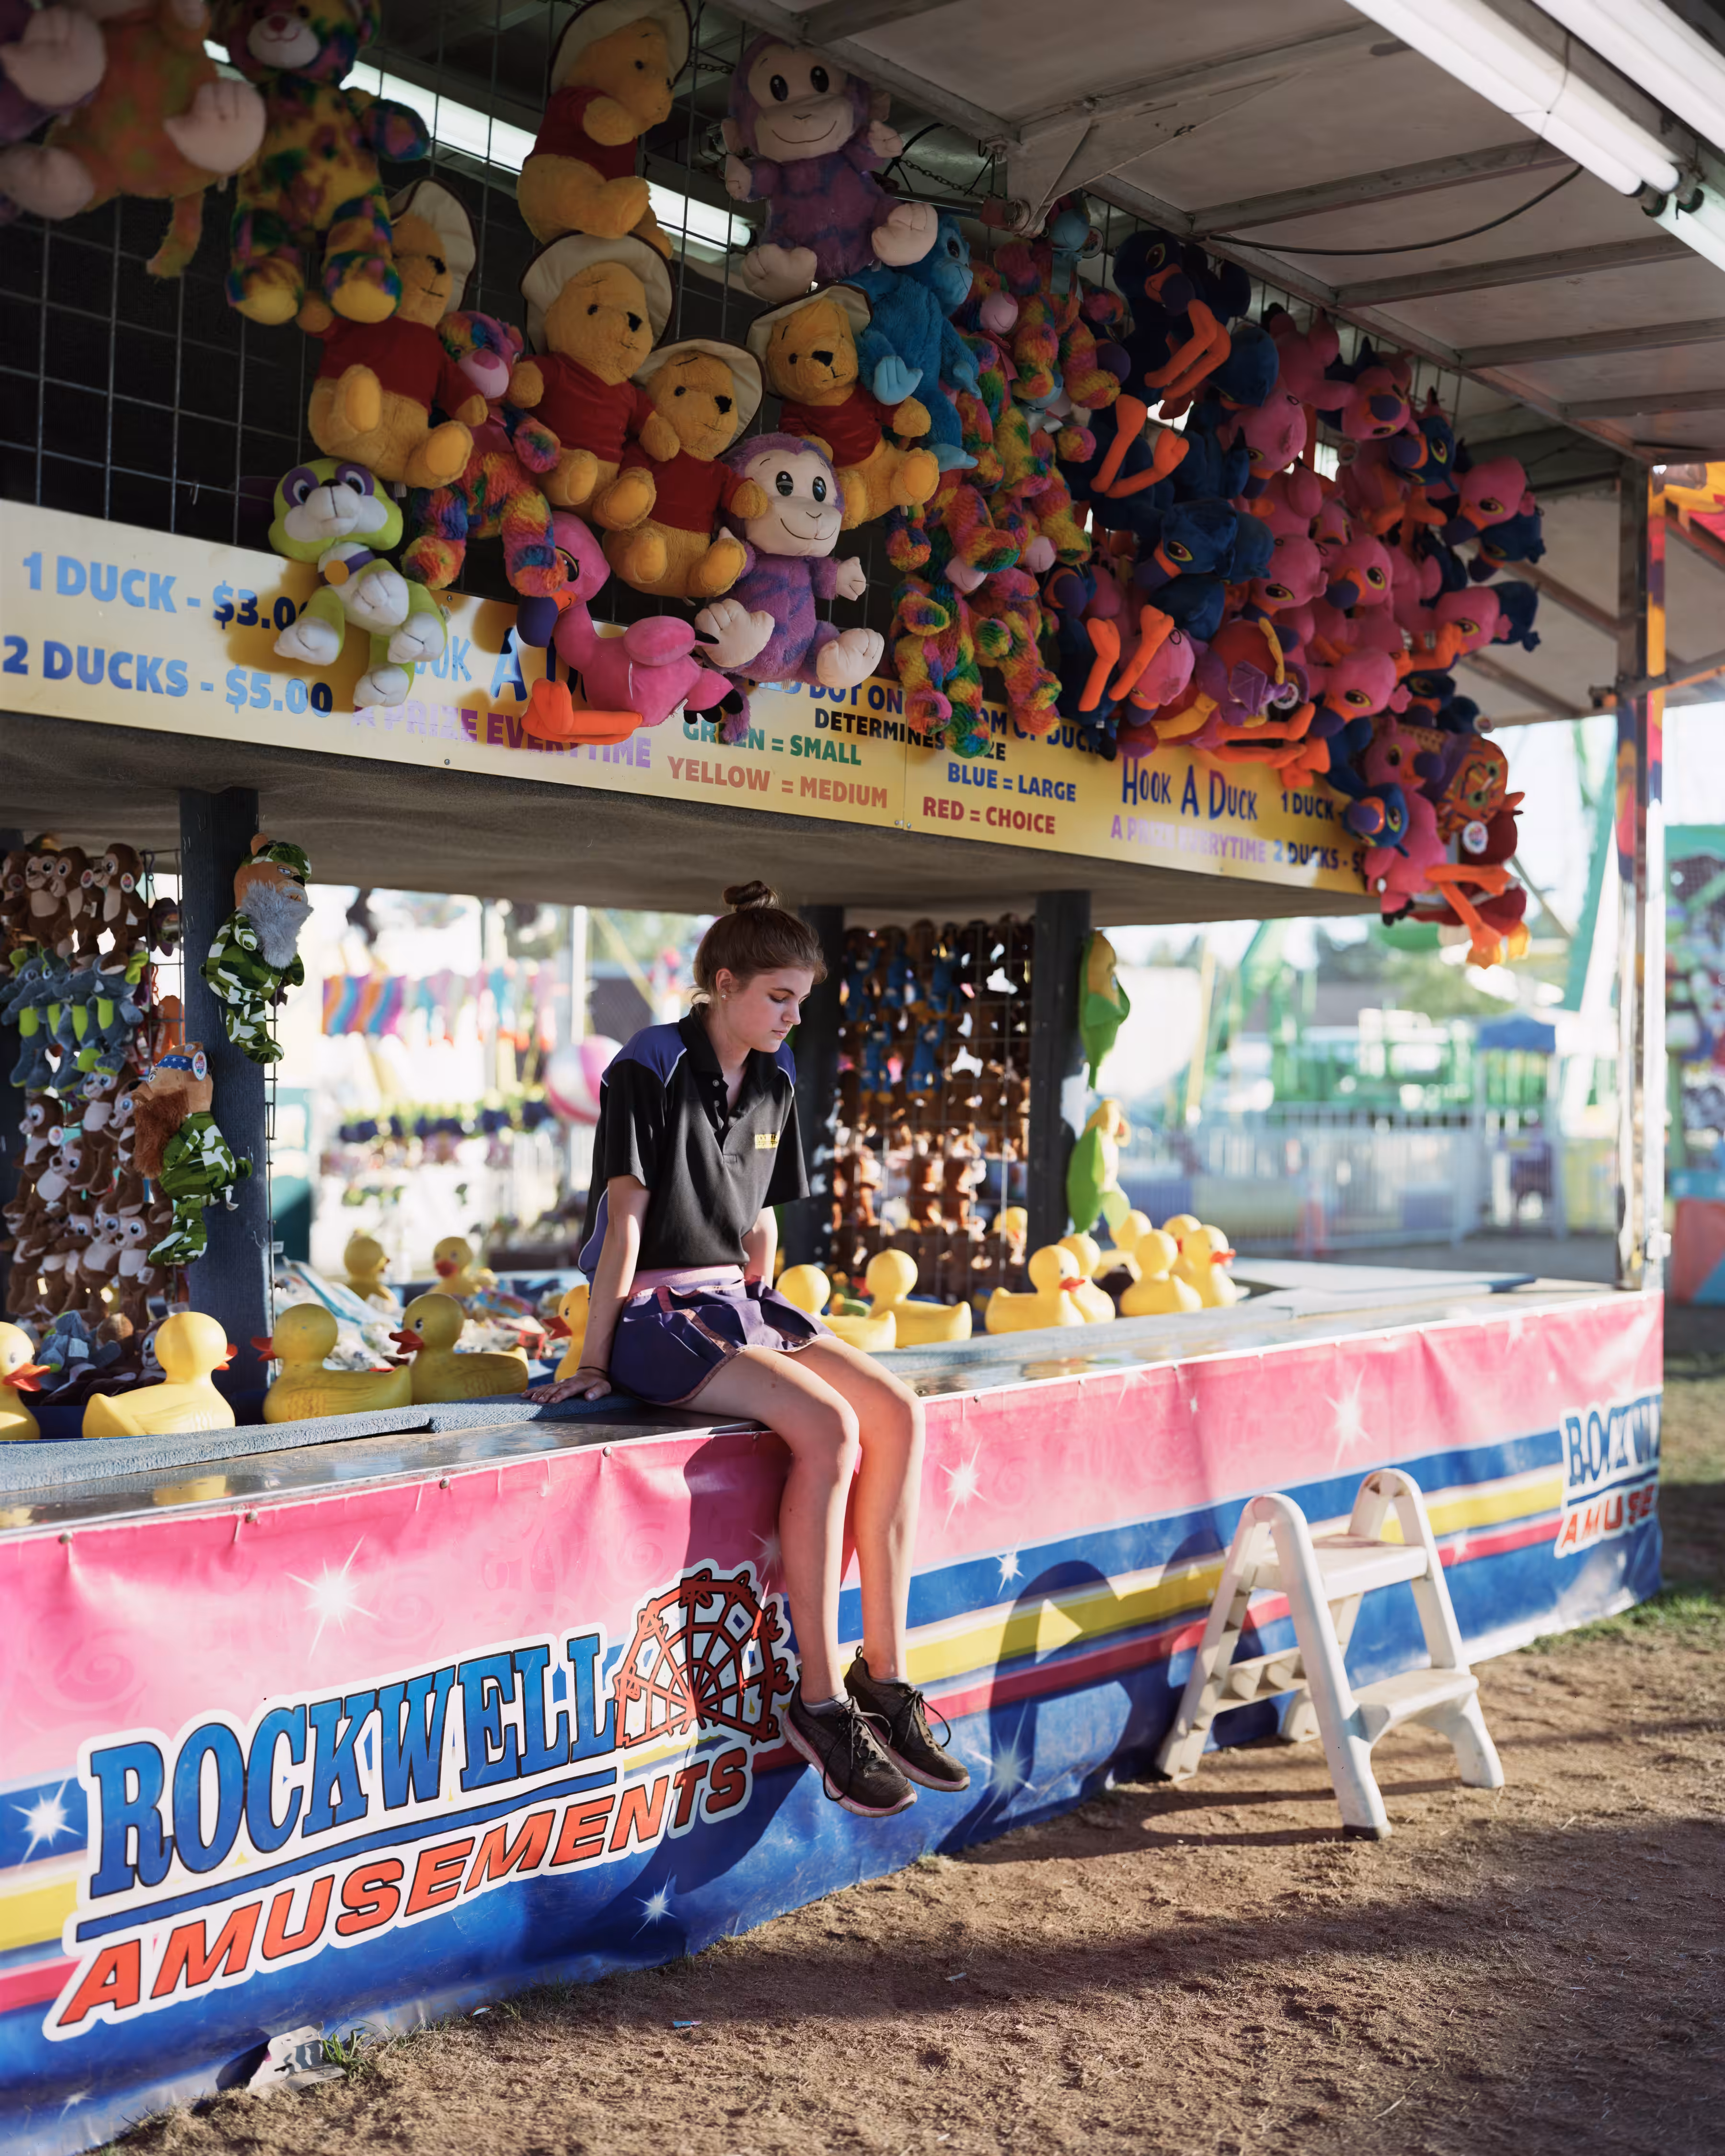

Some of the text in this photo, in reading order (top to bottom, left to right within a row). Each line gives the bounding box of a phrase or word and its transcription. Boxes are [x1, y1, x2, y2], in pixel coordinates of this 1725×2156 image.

[23, 552, 42, 591] 1
[56, 555, 177, 613] DUCK
[213, 580, 308, 632] $3.0
[2, 635, 29, 675] 2
[43, 641, 188, 697] DUCKS
[226, 664, 334, 718] $5.00
[490, 627, 528, 702] A
[868, 685, 903, 714] ON
[384, 700, 479, 744] PRIZE
[790, 734, 862, 766] SMALL
[667, 756, 770, 792] YELLOW
[800, 775, 888, 809] MEDIUM
[948, 762, 998, 790] BLUE
[1018, 774, 1076, 803] LARGE
[1180, 764, 1200, 817] A
[923, 796, 965, 821] RED
[986, 806, 1056, 835] CHOICE
[1110, 814, 1123, 840] A
[1281, 790, 1288, 813] 1
[1292, 792, 1335, 821] DUCK
[1273, 839, 1284, 862] 2
[1288, 841, 1339, 870] DUCKS
[90, 1632, 619, 1899] ROCKWELL
[56, 1746, 750, 2028] AMUSEMENTS
